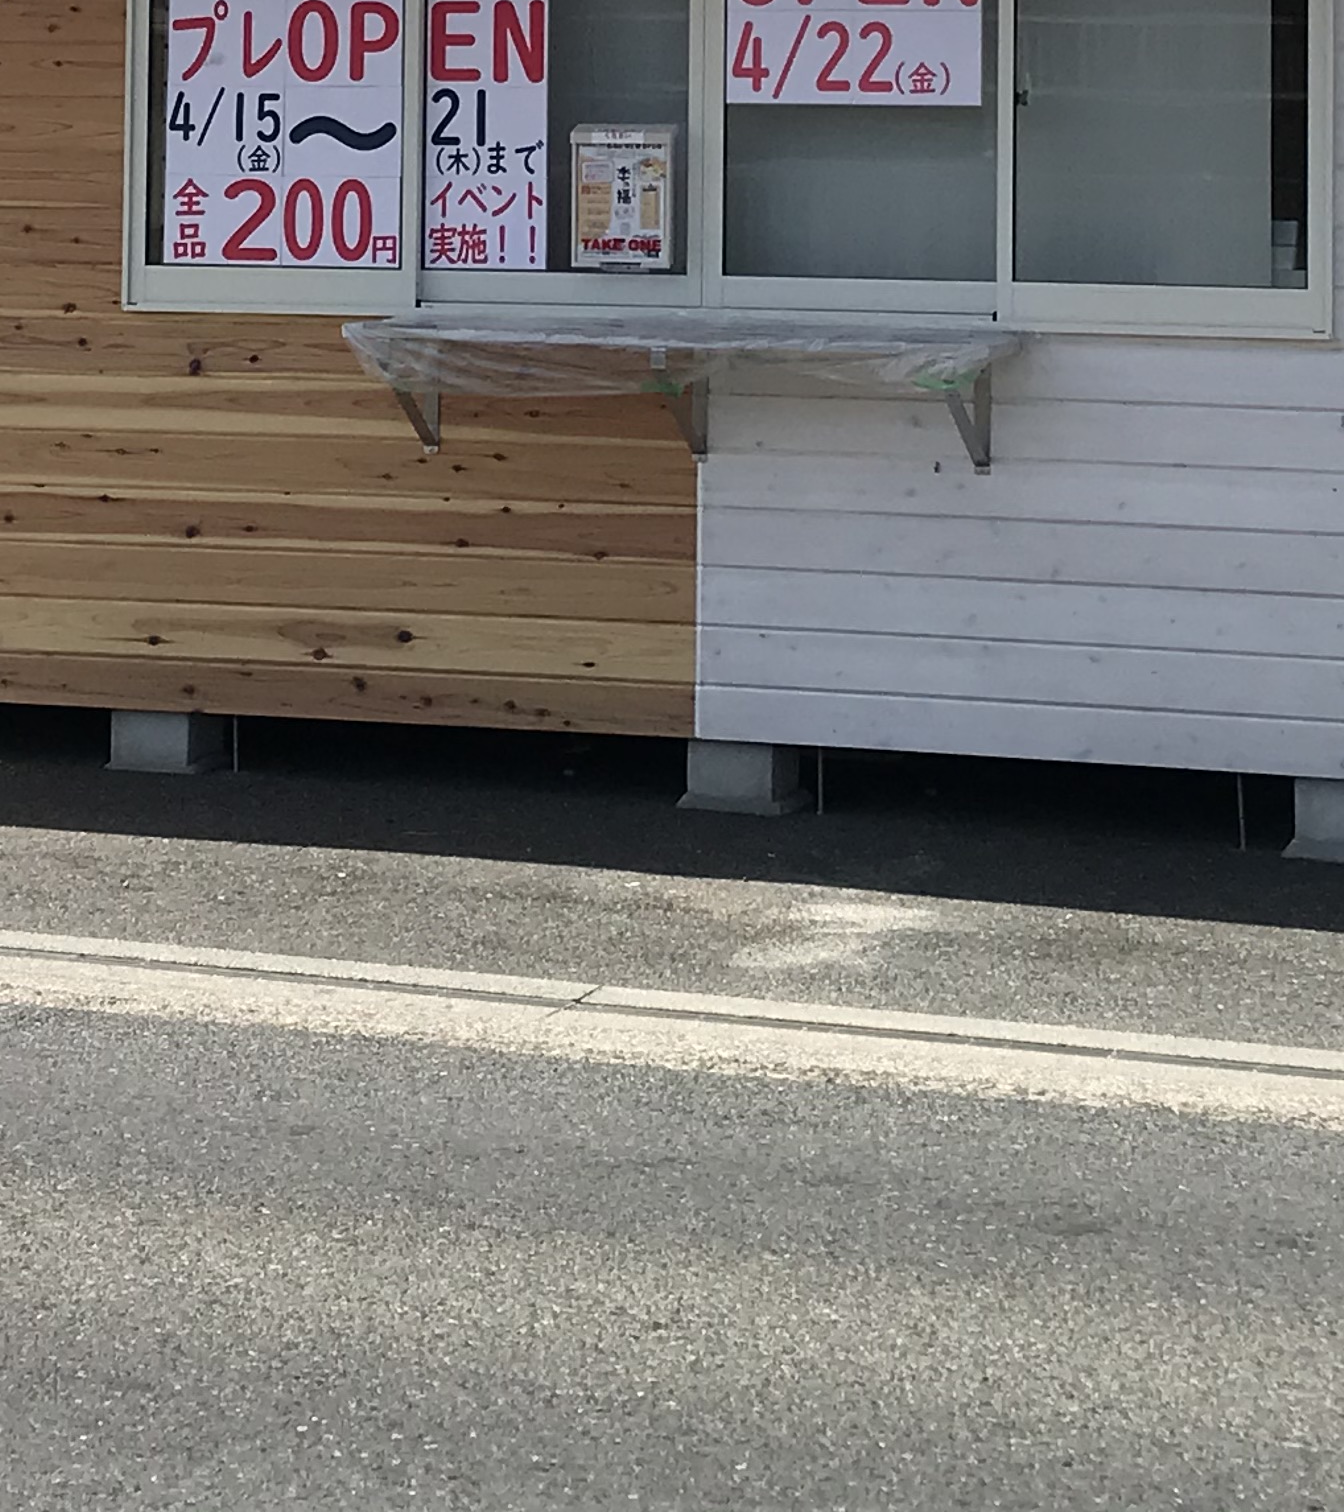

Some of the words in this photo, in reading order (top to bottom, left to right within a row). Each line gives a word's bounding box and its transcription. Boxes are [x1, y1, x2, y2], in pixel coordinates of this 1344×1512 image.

[430, 181, 544, 220] イベント
[580, 238, 626, 252] TAKE
[628, 239, 662, 252] ONE
